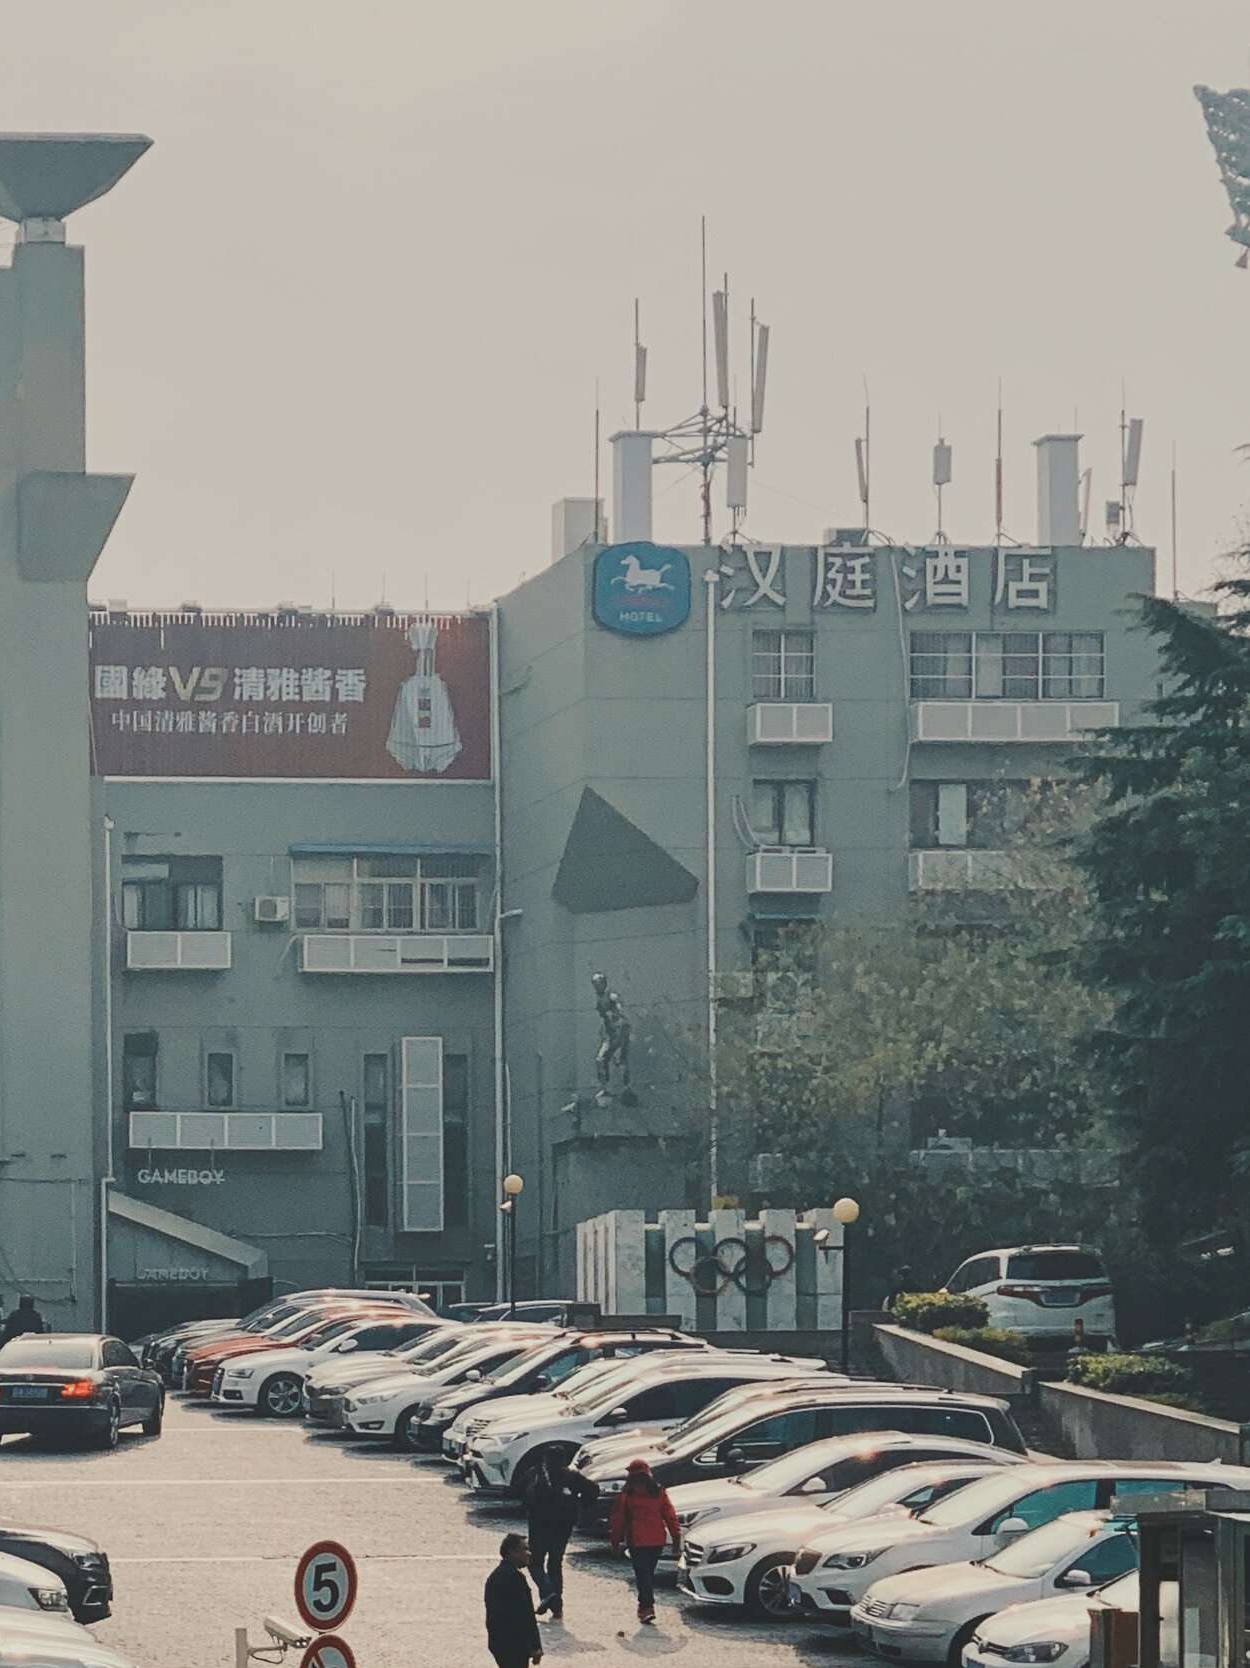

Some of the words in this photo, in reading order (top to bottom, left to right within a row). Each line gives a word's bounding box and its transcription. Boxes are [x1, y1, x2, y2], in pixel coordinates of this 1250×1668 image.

[719, 543, 1051, 610] 汉庭酒店
[619, 611, 662, 623] HOTEL
[111, 710, 348, 735] 中国清雅酱香白酒开创者
[138, 1168, 225, 1185] GAMEBOY
[312, 1561, 340, 1614] 5
